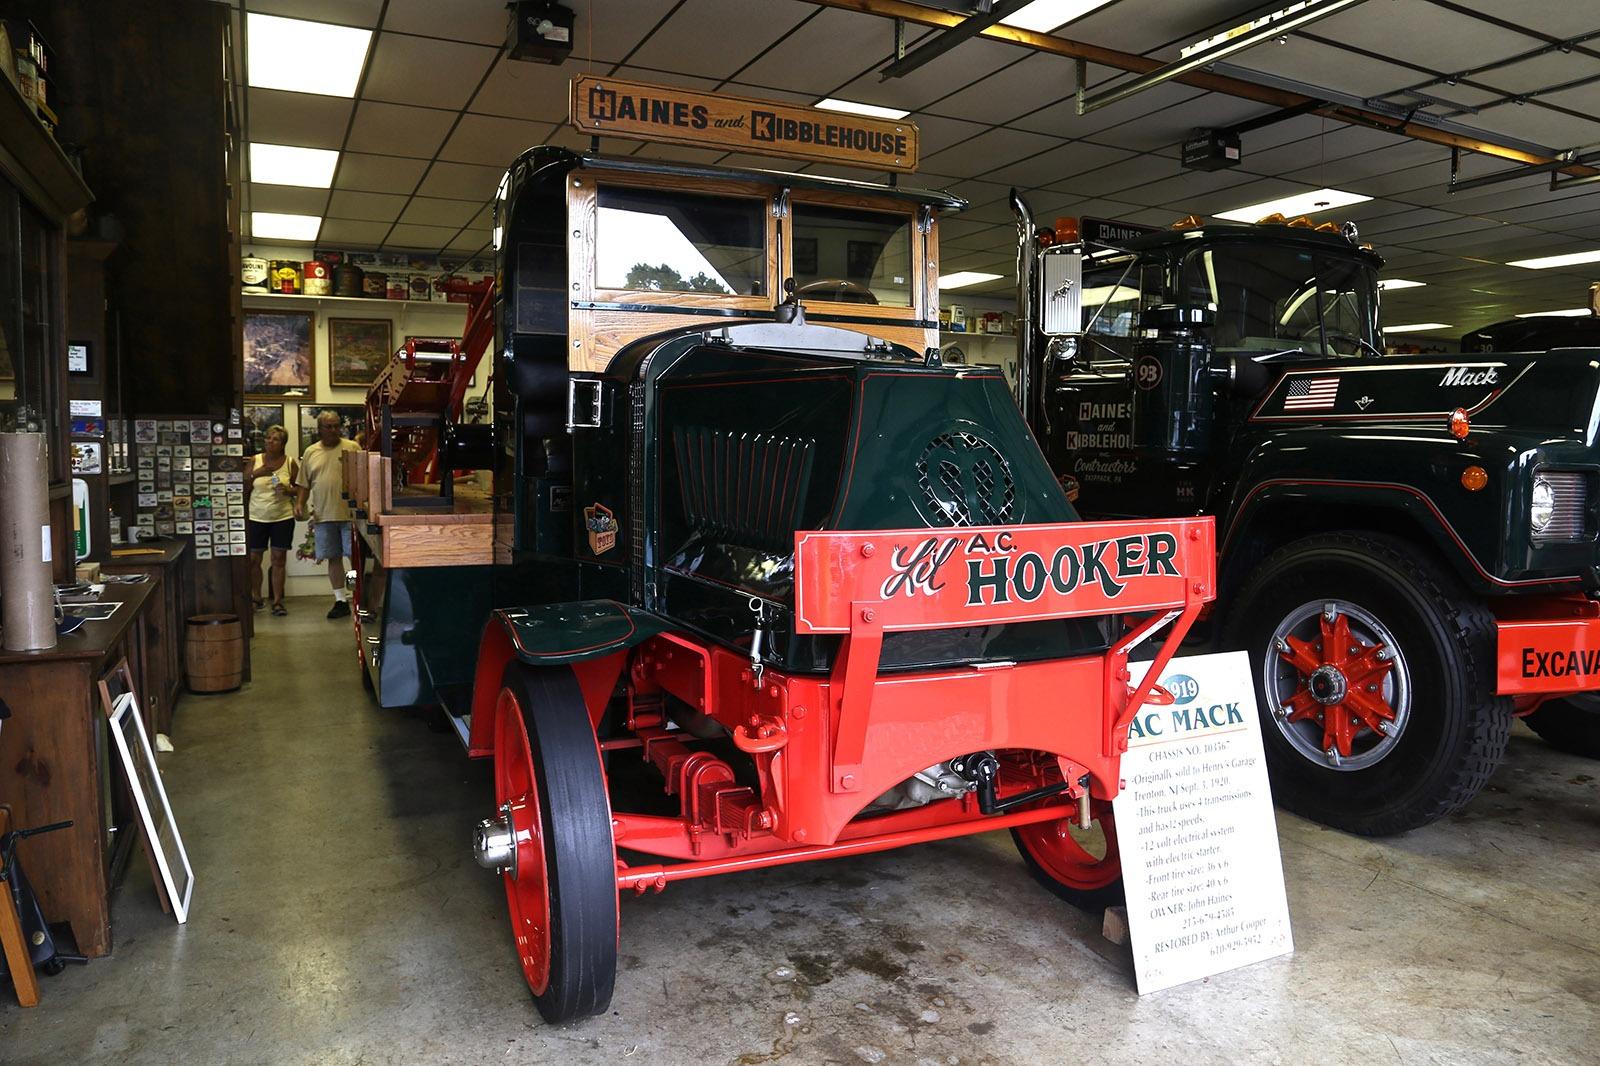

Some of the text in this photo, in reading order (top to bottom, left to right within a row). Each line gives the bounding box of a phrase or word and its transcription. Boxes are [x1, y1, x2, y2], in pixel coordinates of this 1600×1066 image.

[589, 87, 907, 157] HAINES and KIBBLEHOUSE
[1139, 364, 1158, 382] 93
[1438, 366, 1498, 387] Mack
[1096, 421, 1117, 433] and
[1073, 457, 1137, 474] Contractors
[964, 531, 1018, 556] A.C.
[964, 531, 1182, 608] HOOKER
[1128, 701, 1244, 739] AC MACK
[1149, 749, 1184, 762] CHASSIS
[1175, 766, 1191, 778] sold
[1192, 765, 1201, 775] to
[1231, 757, 1257, 770] Garage
[1156, 801, 1178, 815] truck
[1179, 800, 1195, 811] uses
[1138, 823, 1154, 836] and
[1156, 836, 1172, 848] volt
[1173, 828, 1209, 846] electrical
[1210, 825, 1236, 839] system
[1145, 856, 1164, 869] with
[1165, 849, 1194, 865] electric
[1172, 868, 1186, 880] tire
[1171, 884, 1185, 898] tire
[1150, 893, 1233, 920] OWNER: John Haines
[1154, 932, 1198, 954] RESTORED
[1215, 923, 1239, 938] Arthur
[1240, 917, 1267, 933] Cooper
